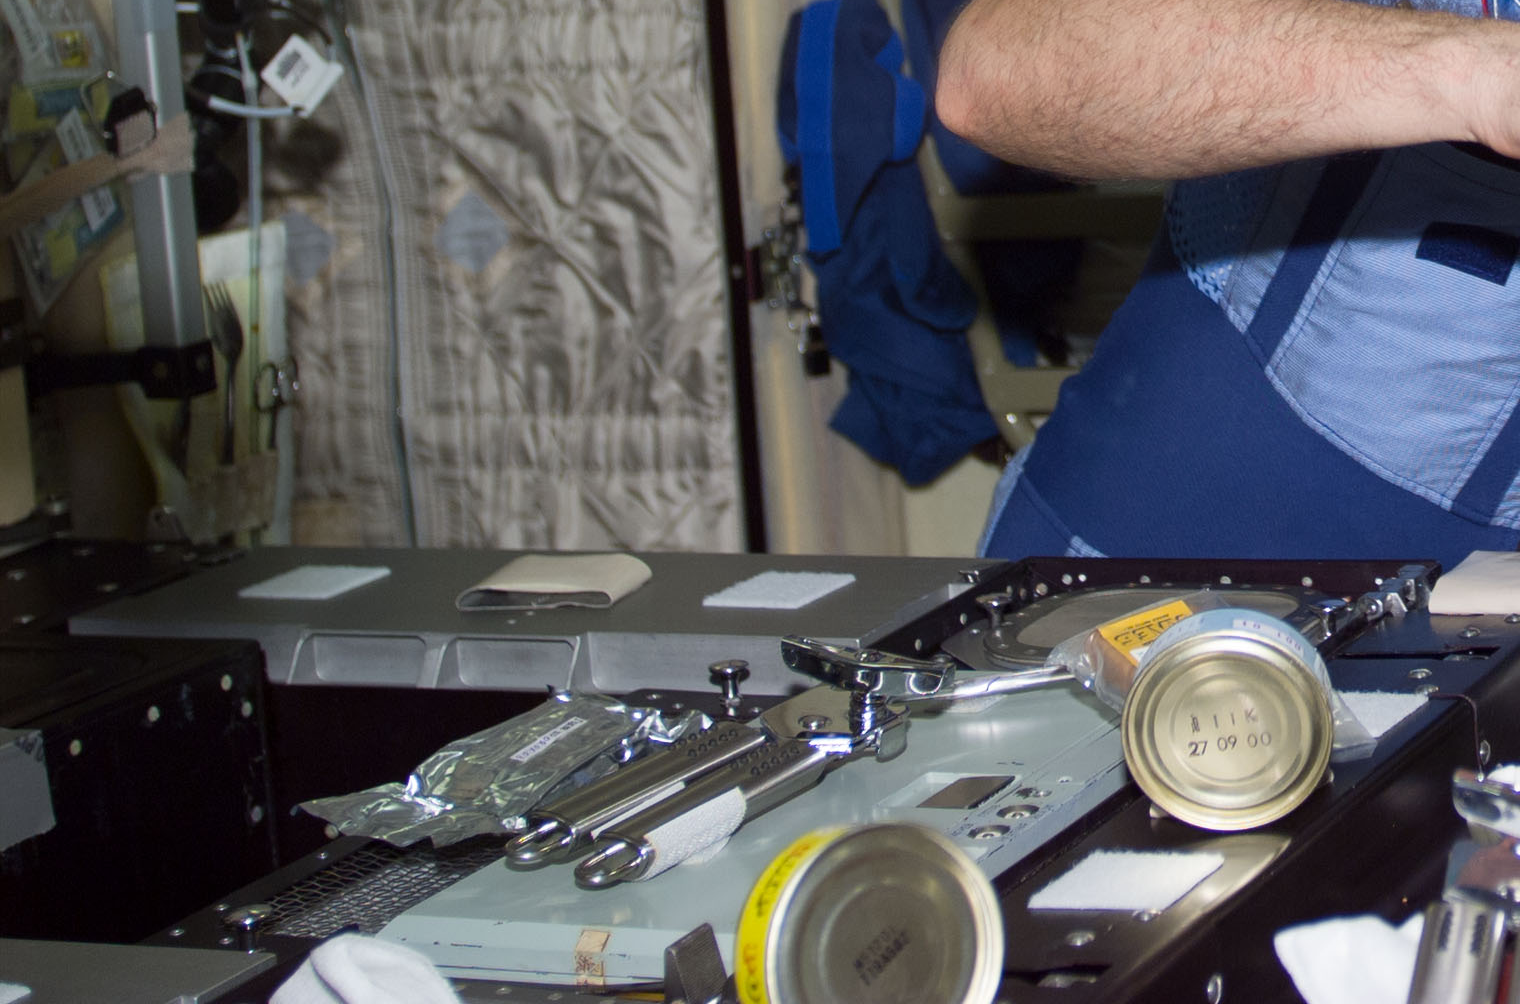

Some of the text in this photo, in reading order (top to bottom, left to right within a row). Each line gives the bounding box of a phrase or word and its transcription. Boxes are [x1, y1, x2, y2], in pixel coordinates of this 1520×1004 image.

[1187, 731, 1272, 757] 27 09 00
